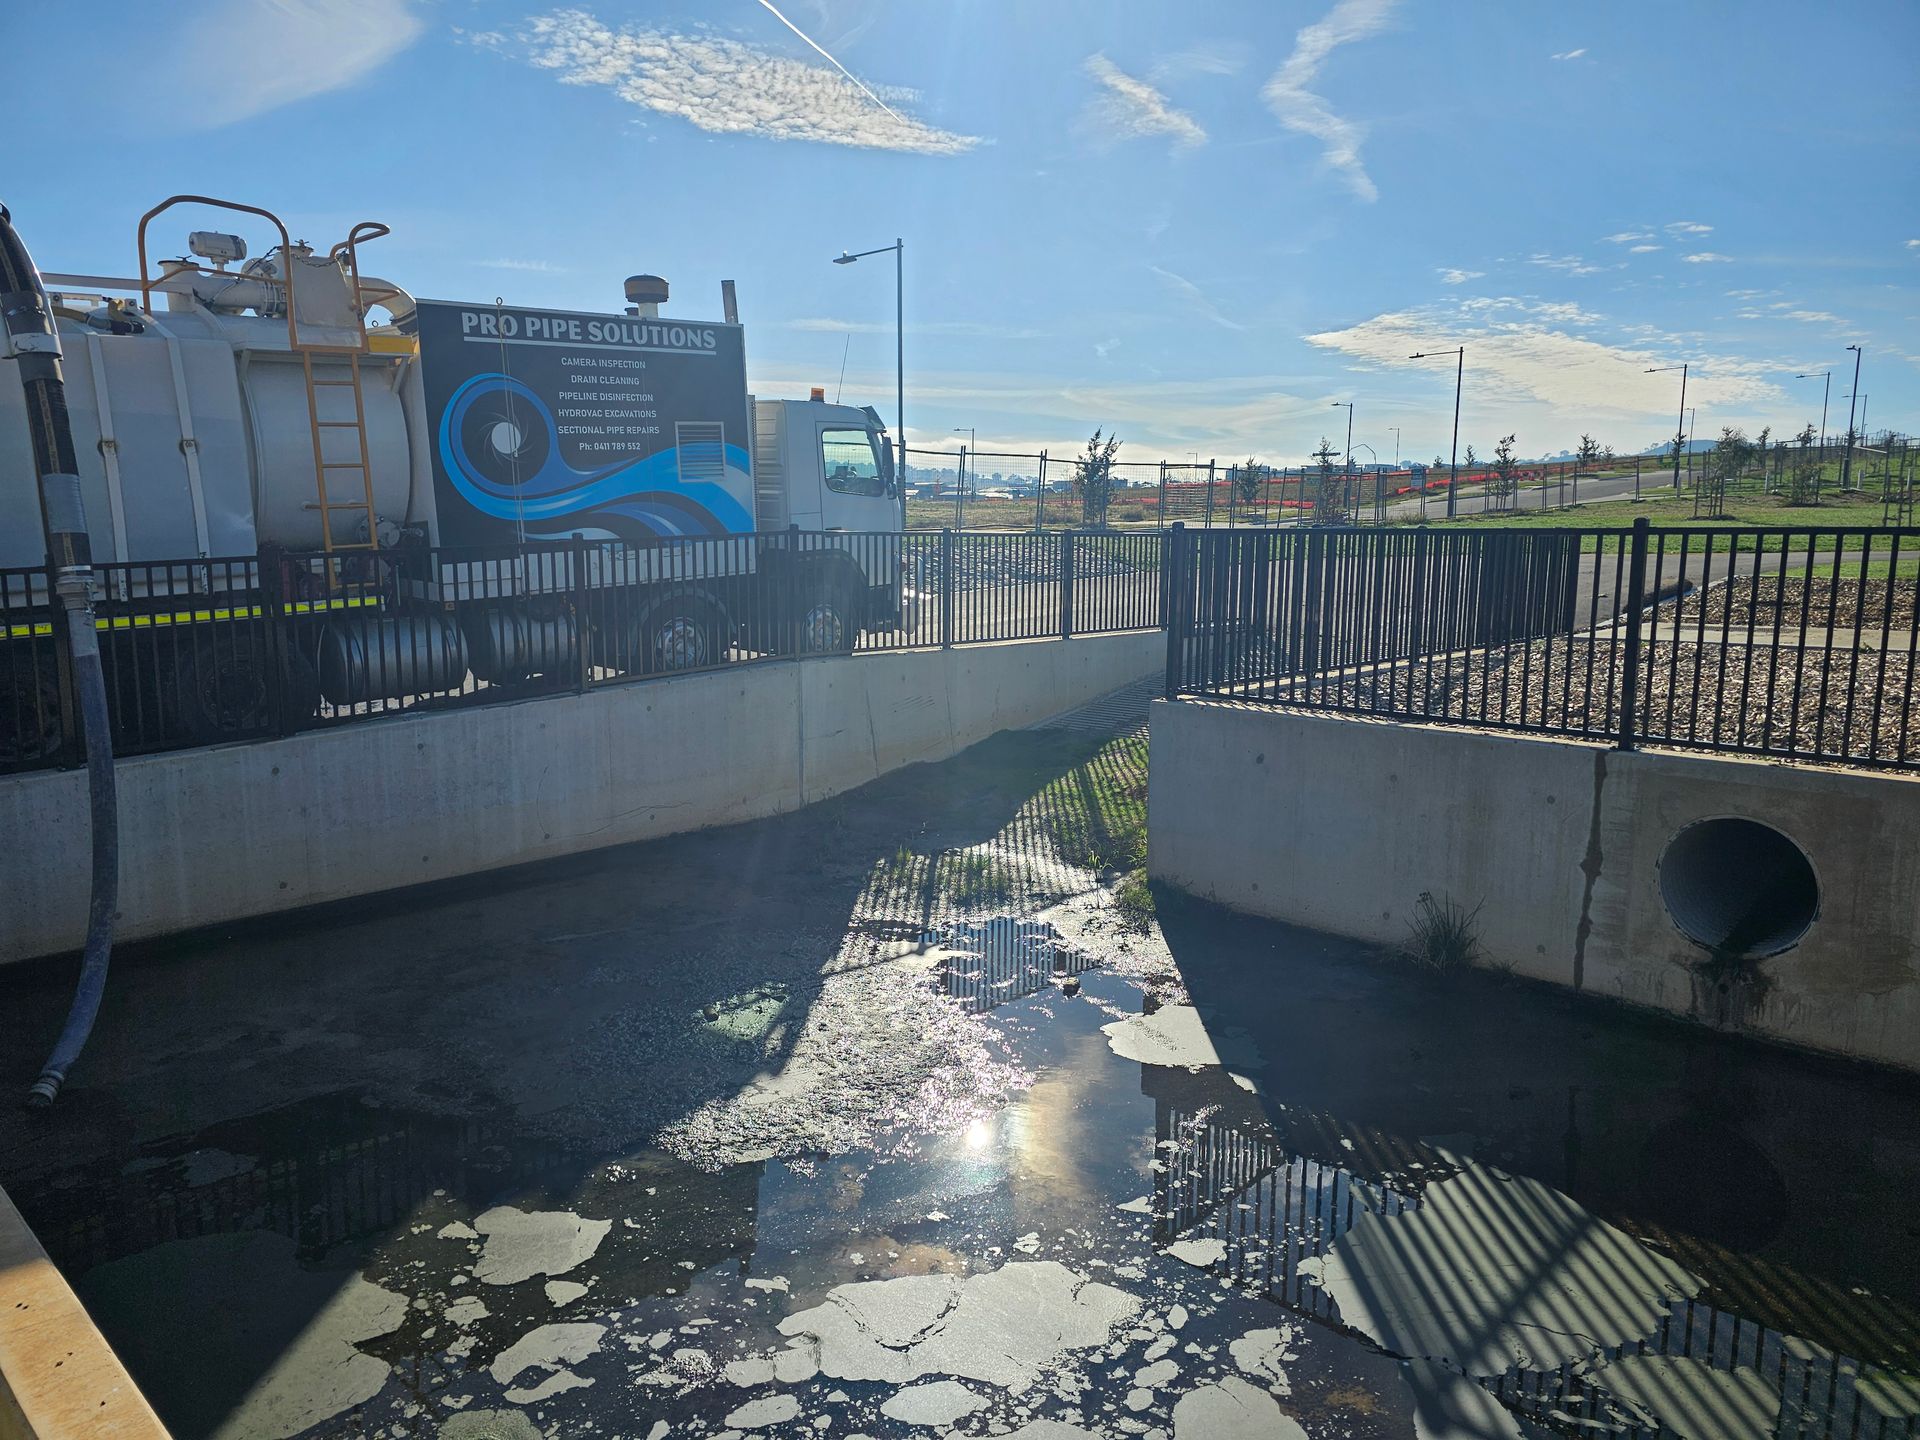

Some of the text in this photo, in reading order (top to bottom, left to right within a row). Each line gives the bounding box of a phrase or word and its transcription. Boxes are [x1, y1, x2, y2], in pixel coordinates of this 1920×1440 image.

[461, 312, 716, 349] PRO PIPE SOLUTIONS
[561, 358, 646, 369] CAMERA INSPECTION
[571, 375, 640, 385] DRAIN CLEANING
[559, 392, 654, 401] PIPELINE DISINFECTION
[558, 409, 657, 418] HYDROVAC EXCAVATIONS
[558, 426, 660, 434] SECTIONAL PIPE REPAIRS
[579, 442, 640, 451] Ph: 0411 789 552
